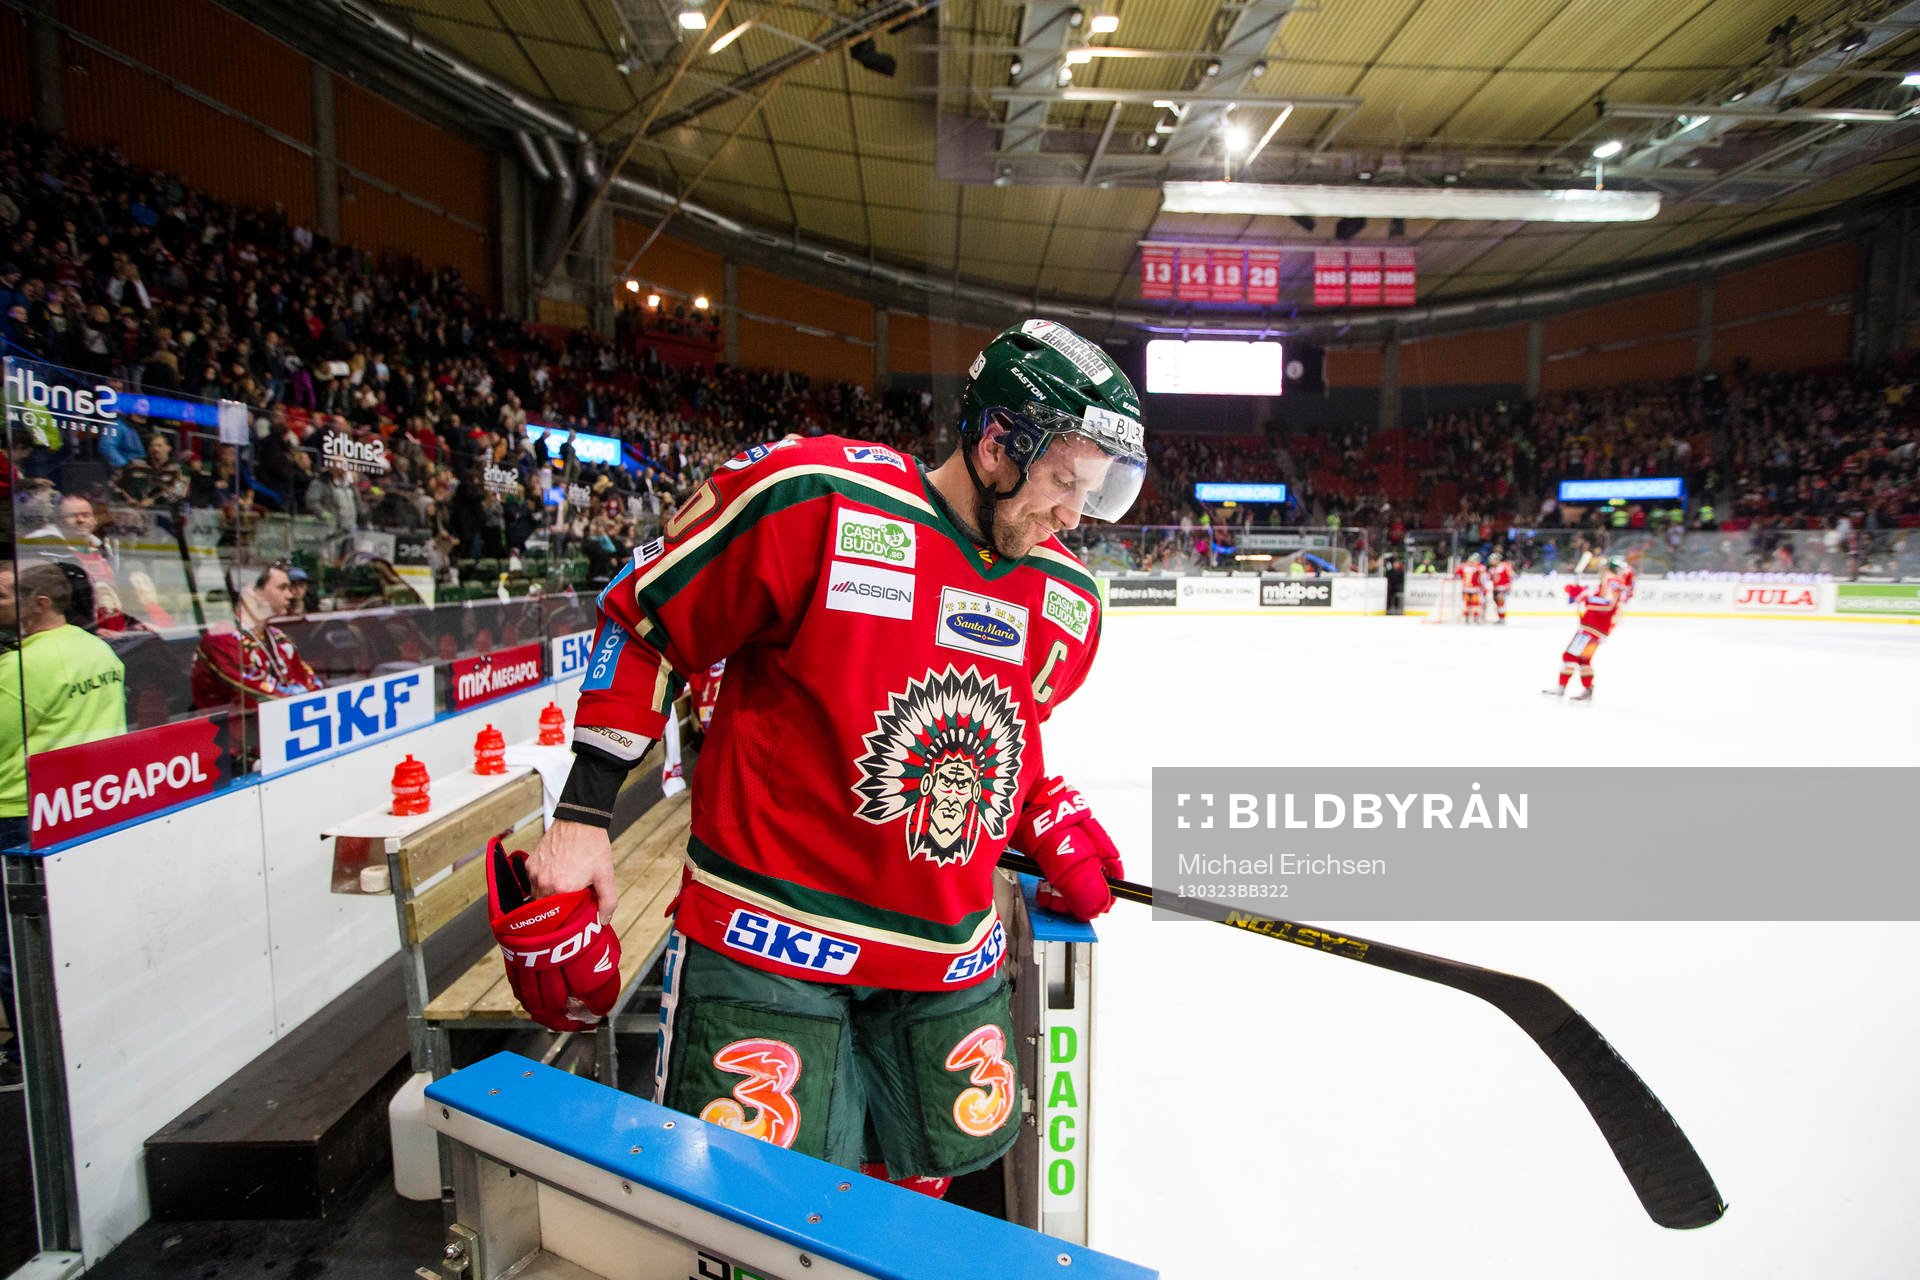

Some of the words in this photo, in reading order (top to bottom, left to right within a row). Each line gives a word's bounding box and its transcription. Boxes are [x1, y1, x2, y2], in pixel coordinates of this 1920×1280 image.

[1146, 262, 1171, 283] 13
[1181, 263, 1207, 284] 14
[1215, 265, 1240, 286] 19
[1249, 266, 1277, 287] 29
[1042, 333, 1098, 377] BEMANNING
[1010, 367, 1047, 401] EASTON
[843, 524, 881, 541] CASH
[846, 581, 912, 603] ASSIGN
[1049, 591, 1073, 611] CASH
[1263, 582, 1329, 600] midbec
[1738, 589, 1814, 605] JULA
[945, 601, 981, 612] TEX
[995, 608, 1024, 631] MEX
[954, 616, 984, 633] Santa
[984, 623, 1015, 641] Maria
[492, 660, 539, 692] MEGAPOL
[1032, 640, 1068, 703] C
[286, 674, 420, 762] SKF
[32, 752, 207, 831] MEGAPOL
[510, 907, 561, 930] LUNDQVIST
[727, 912, 858, 969] SKF
[945, 922, 1003, 980] SKF
[1047, 1026, 1079, 1196] DACO
